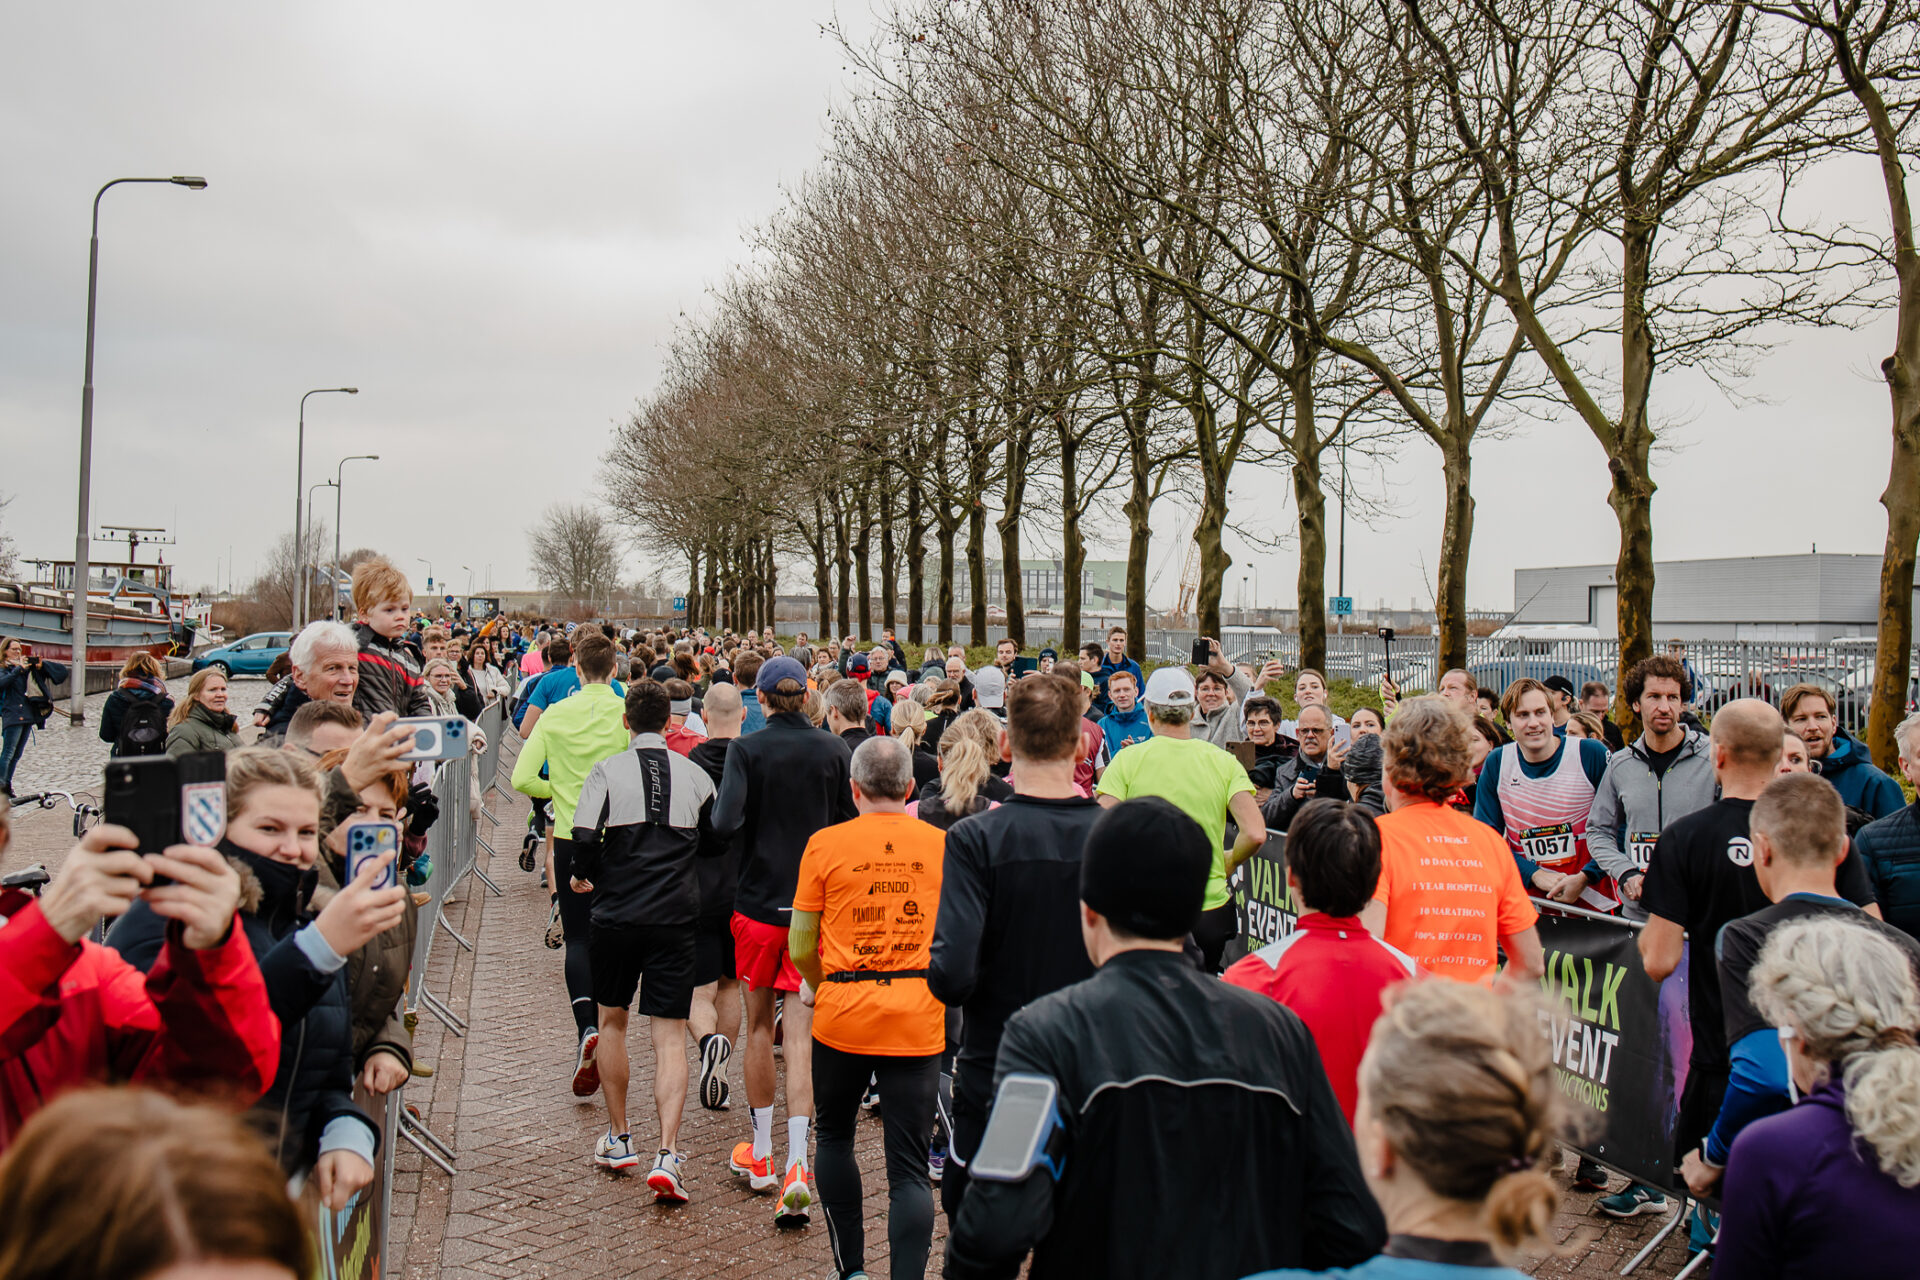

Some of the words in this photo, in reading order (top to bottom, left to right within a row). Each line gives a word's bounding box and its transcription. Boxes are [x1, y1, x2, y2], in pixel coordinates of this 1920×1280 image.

[1337, 600, 1350, 611] B2
[648, 760, 661, 811] ROGELLI
[1433, 836, 1469, 844] STROKE
[1525, 835, 1569, 856] 1057
[1634, 845, 1653, 864] 10
[1420, 858, 1430, 866] 10
[1432, 858, 1454, 867] DAYS
[1455, 859, 1483, 868] COMA
[874, 882, 909, 893] RENDO
[1419, 882, 1444, 891] YEAR
[1446, 883, 1492, 893] HOSPITALS
[1420, 907, 1430, 915] 10
[1432, 907, 1486, 918] MARATHONS
[1247, 900, 1298, 944] EVENT
[1414, 931, 1435, 940] 100%
[1438, 932, 1483, 942] RECOVERY
[1441, 955, 1453, 964] DO
[1454, 956, 1464, 964] IT
[1540, 948, 1628, 1031] VALK
[1554, 1067, 1610, 1112] DUCTIONS
